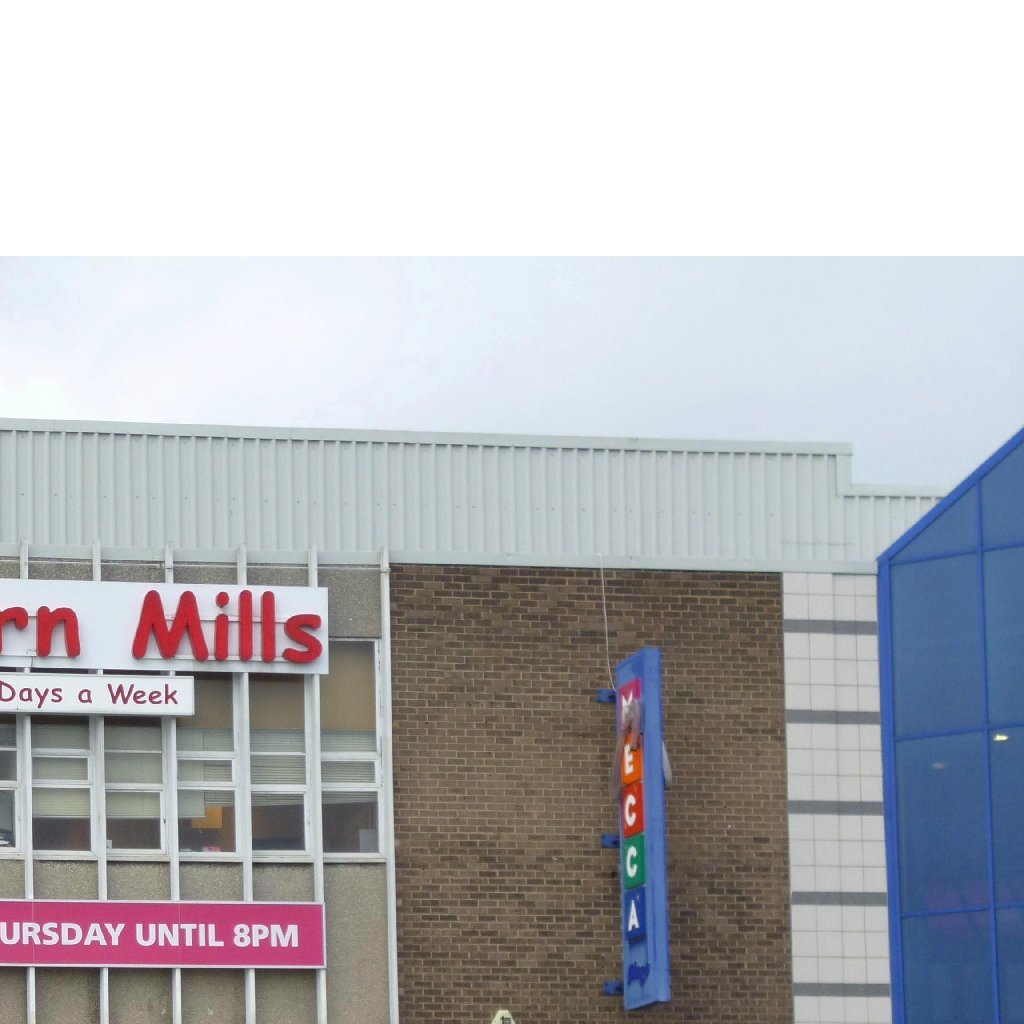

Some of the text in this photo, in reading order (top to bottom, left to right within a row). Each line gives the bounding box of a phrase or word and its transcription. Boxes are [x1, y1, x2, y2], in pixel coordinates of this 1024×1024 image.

[132, 589, 324, 664] Mills
[78, 688, 93, 705] a
[107, 682, 179, 705] Week
[136, 923, 224, 948] UNTIL
[233, 923, 299, 948] 8PM
